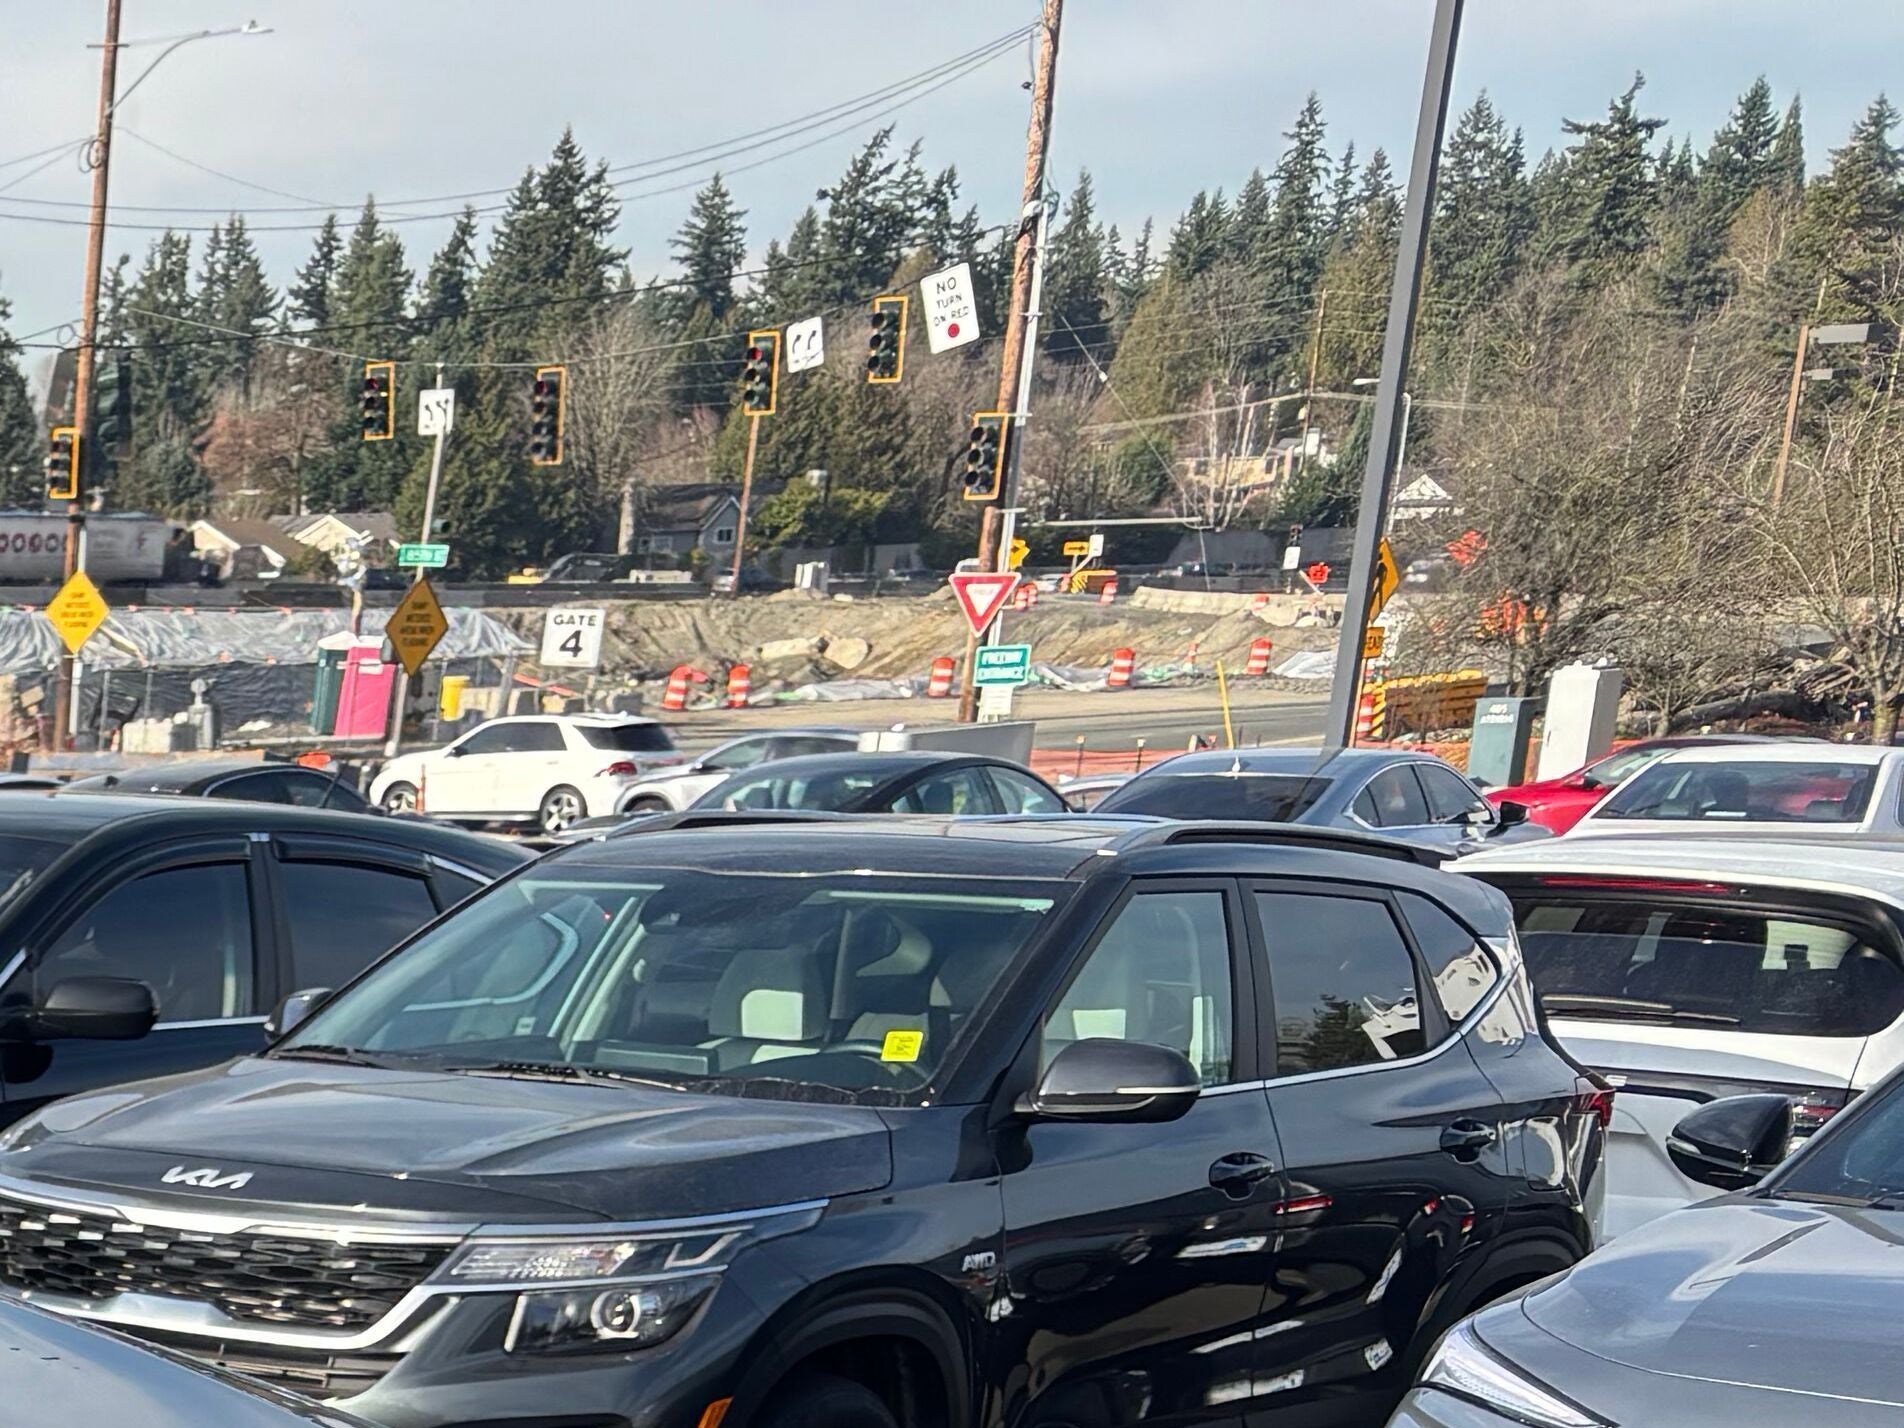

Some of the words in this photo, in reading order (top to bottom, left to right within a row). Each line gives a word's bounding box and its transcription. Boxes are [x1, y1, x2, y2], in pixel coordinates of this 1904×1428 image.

[936, 276, 957, 294] NO
[936, 293, 962, 309] TURN
[553, 613, 597, 627] GATE
[559, 629, 583, 658] 4
